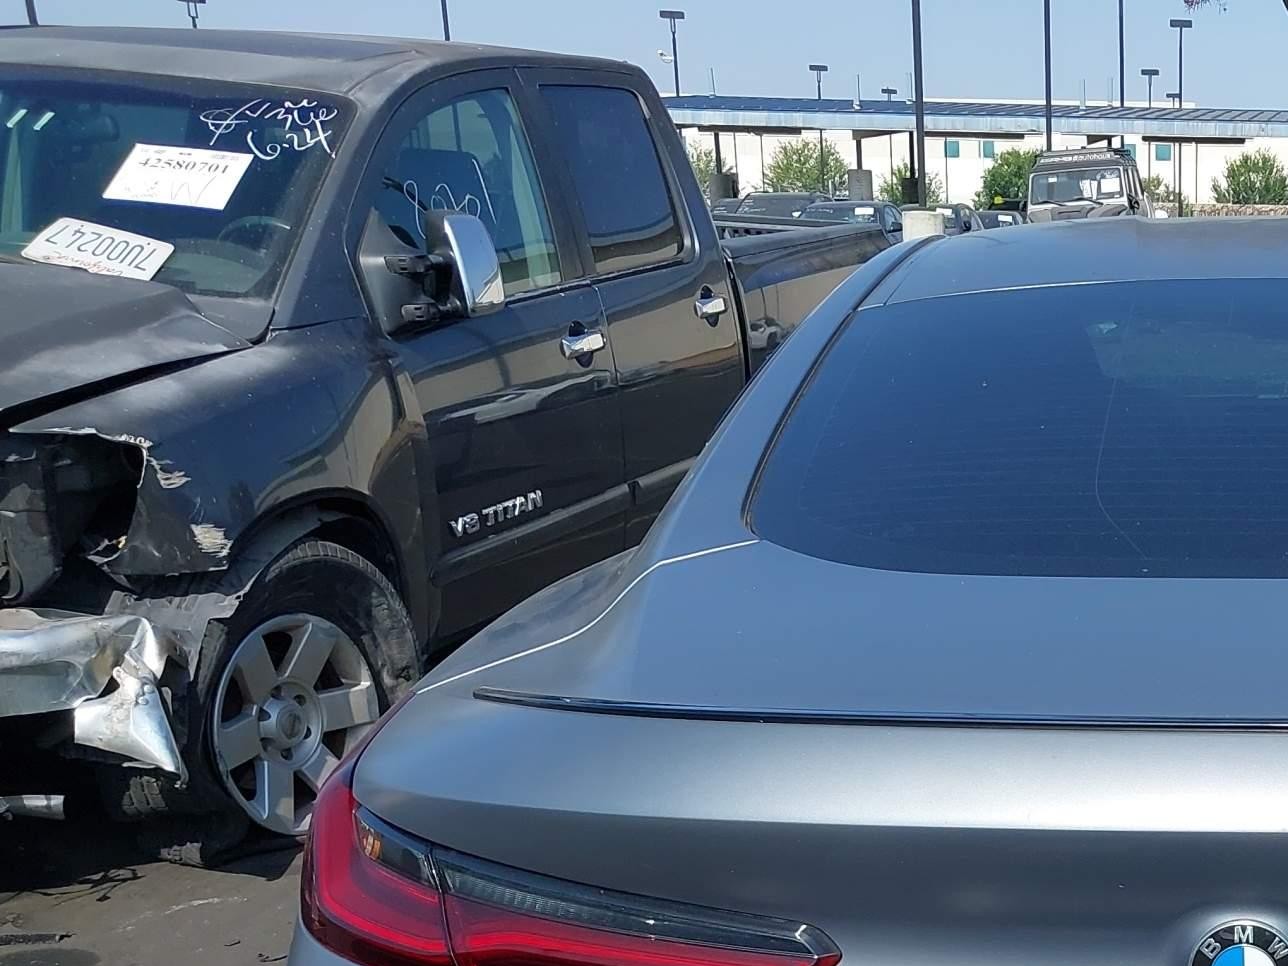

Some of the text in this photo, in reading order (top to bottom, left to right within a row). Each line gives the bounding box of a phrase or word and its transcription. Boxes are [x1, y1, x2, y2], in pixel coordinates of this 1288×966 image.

[138, 158, 230, 174] 42580701
[44, 224, 157, 272] 7U00247
[482, 489, 544, 527] TITAN
